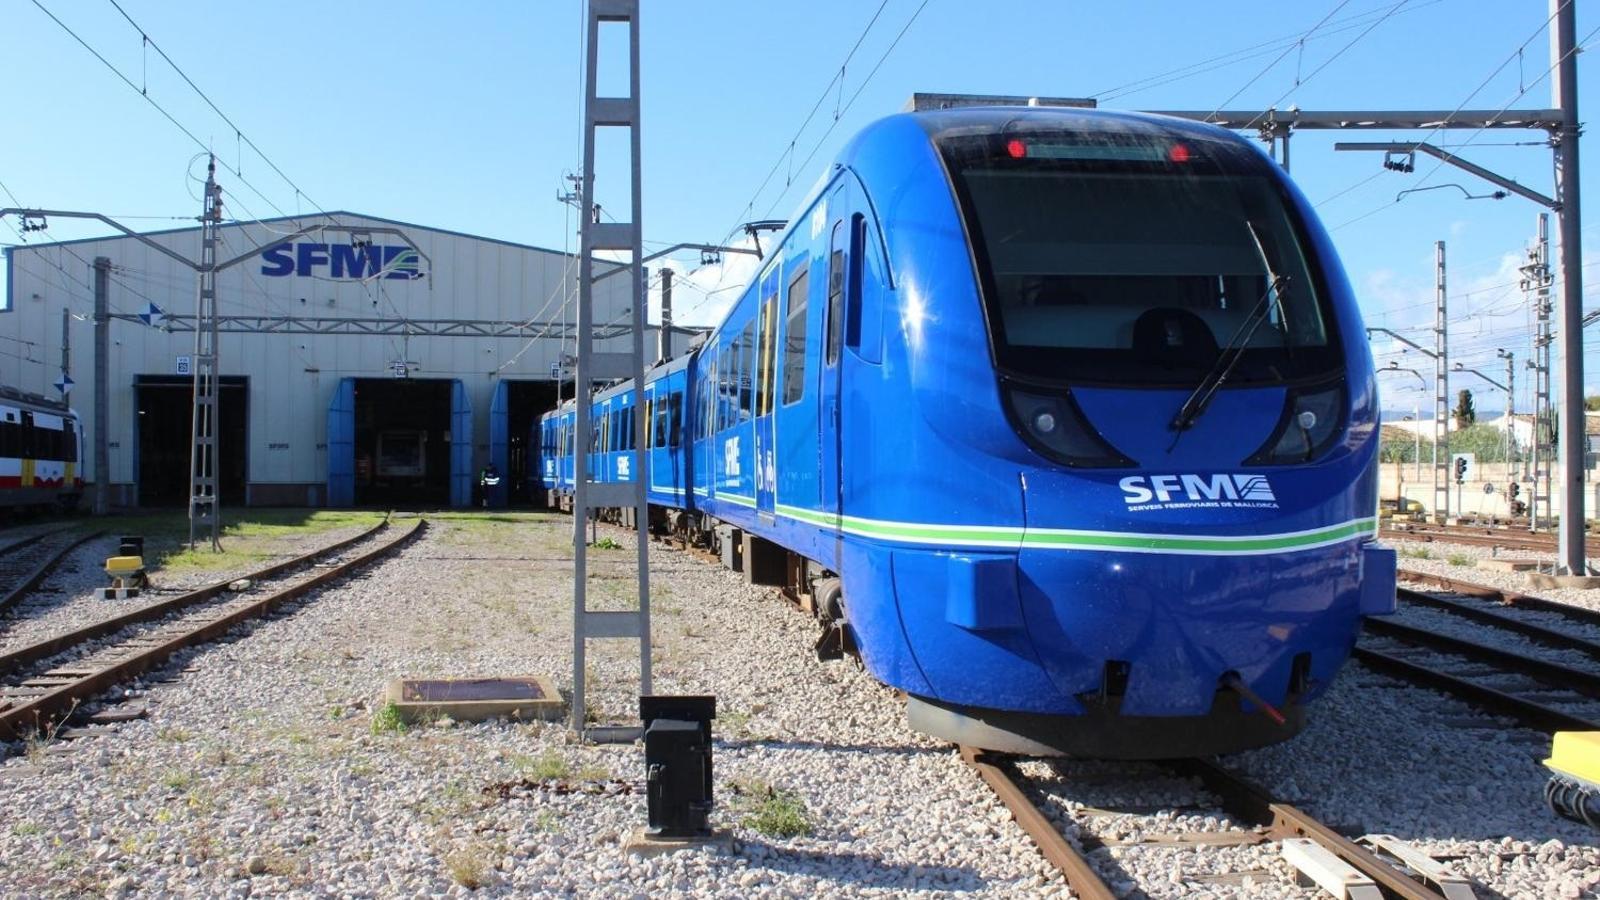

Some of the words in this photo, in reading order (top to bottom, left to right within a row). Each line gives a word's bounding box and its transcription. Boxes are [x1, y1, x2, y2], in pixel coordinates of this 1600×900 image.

[261, 243, 382, 278] SFM
[1119, 474, 1239, 503] SFM
[1128, 504, 1163, 512] SERVEIS
[1233, 501, 1280, 509] MALLORCA
